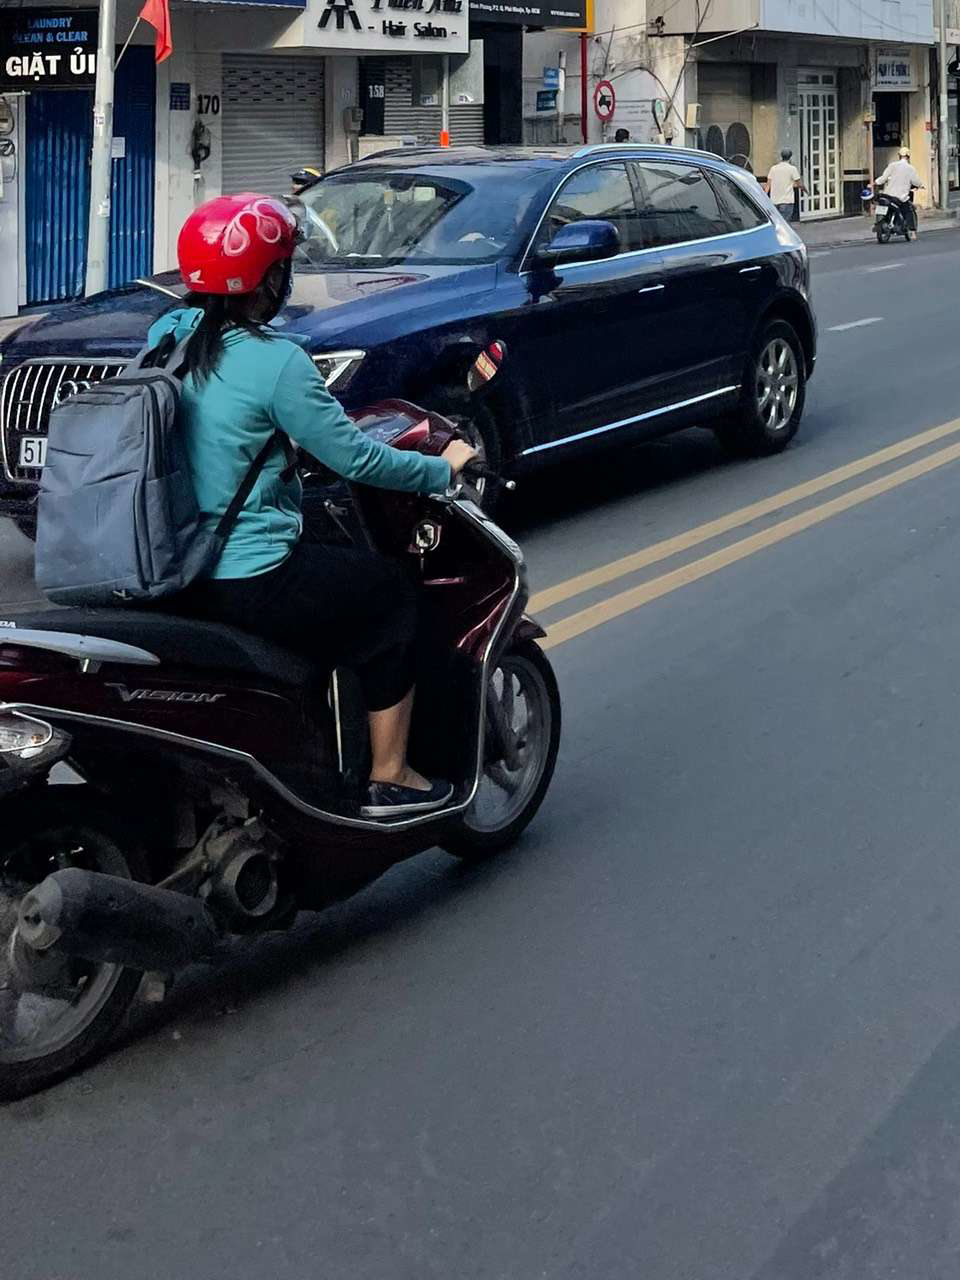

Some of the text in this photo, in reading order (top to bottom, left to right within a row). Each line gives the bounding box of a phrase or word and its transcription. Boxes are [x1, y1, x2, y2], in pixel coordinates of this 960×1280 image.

[56, 31, 88, 42] CLEAR
[382, 20, 447, 38] Hair Salon
[5, 46, 96, 81] GIẶT ỦI
[198, 95, 220, 115] 170
[24, 440, 42, 464] 51
[104, 682, 227, 703] VISION
